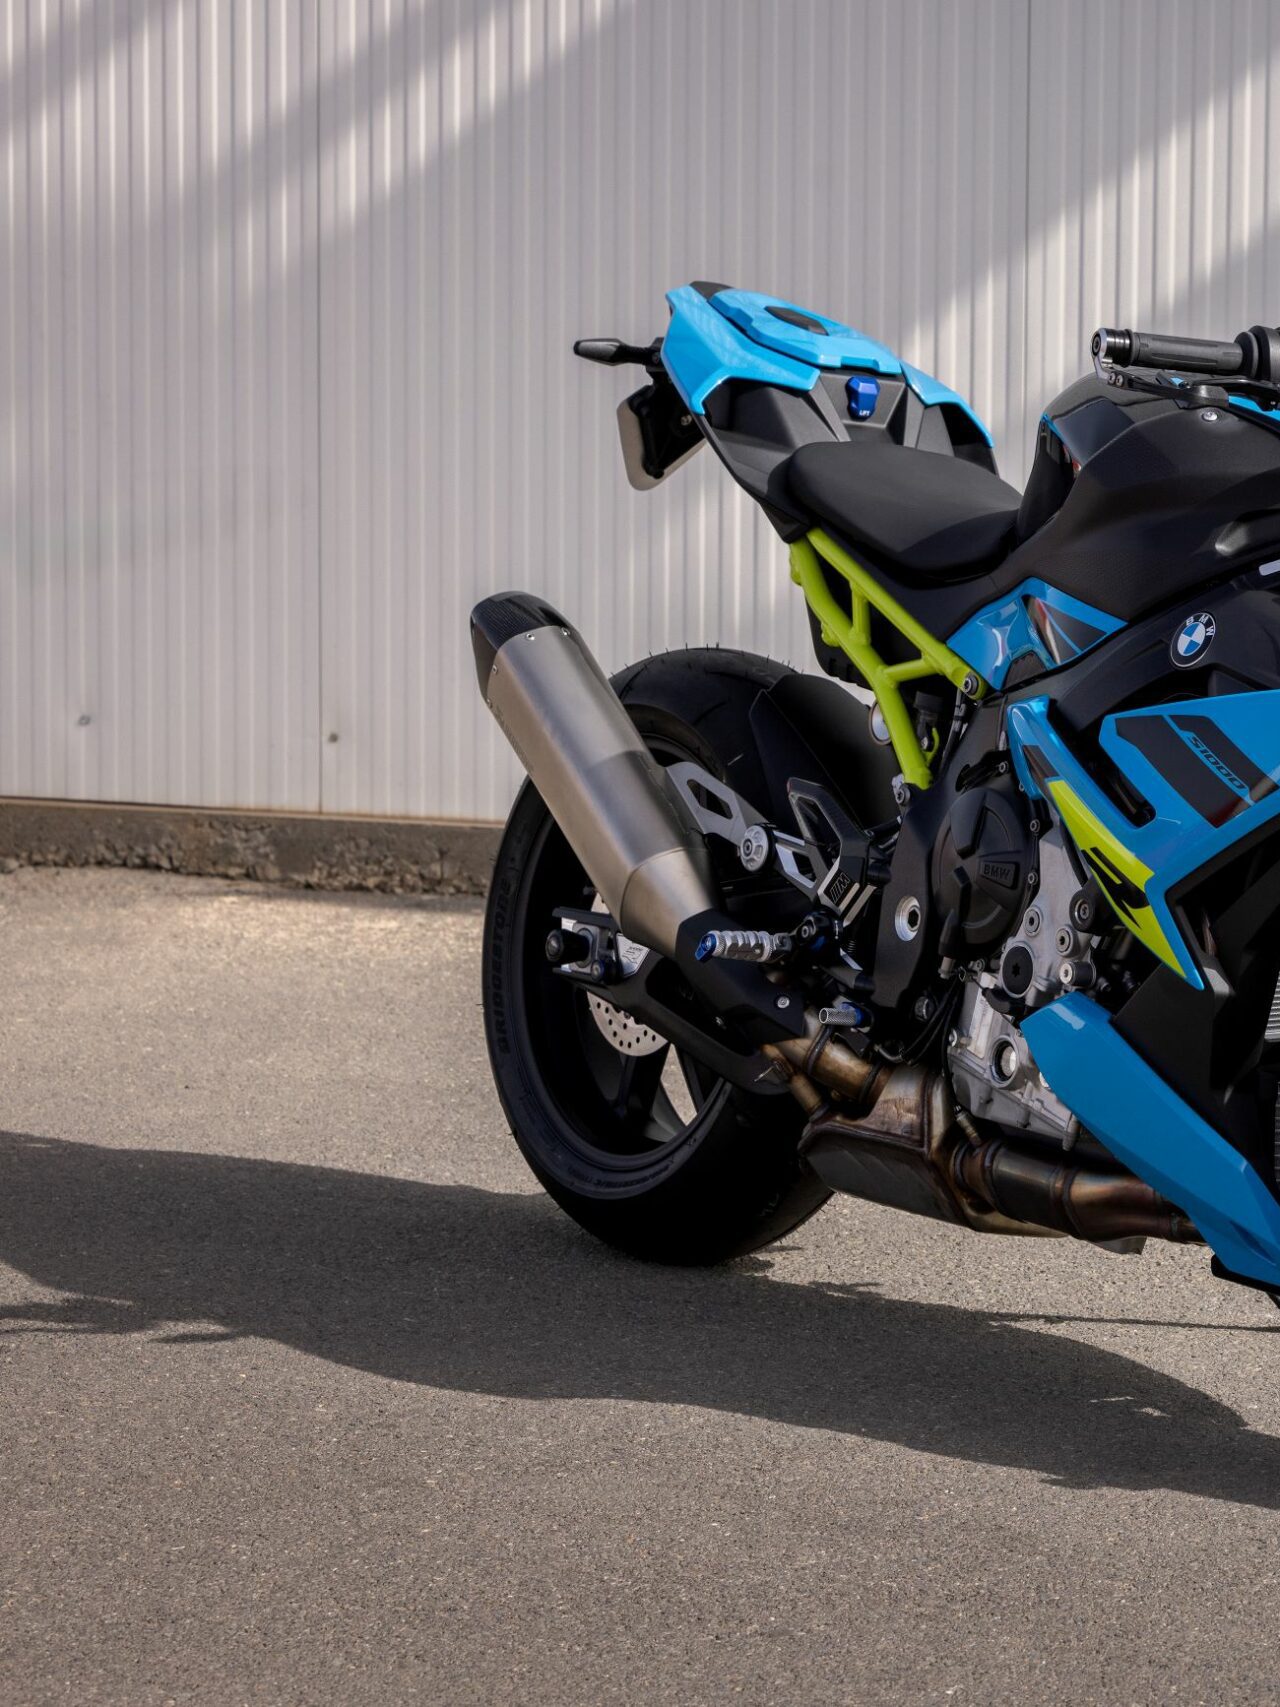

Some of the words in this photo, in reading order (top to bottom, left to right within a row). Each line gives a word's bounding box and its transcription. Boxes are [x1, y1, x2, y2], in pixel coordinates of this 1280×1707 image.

[1186, 614, 1214, 636] BMW
[1187, 736, 1248, 790] S1000
[983, 863, 1011, 881] BMW
[491, 878, 511, 1055] BRIDGESTONE
